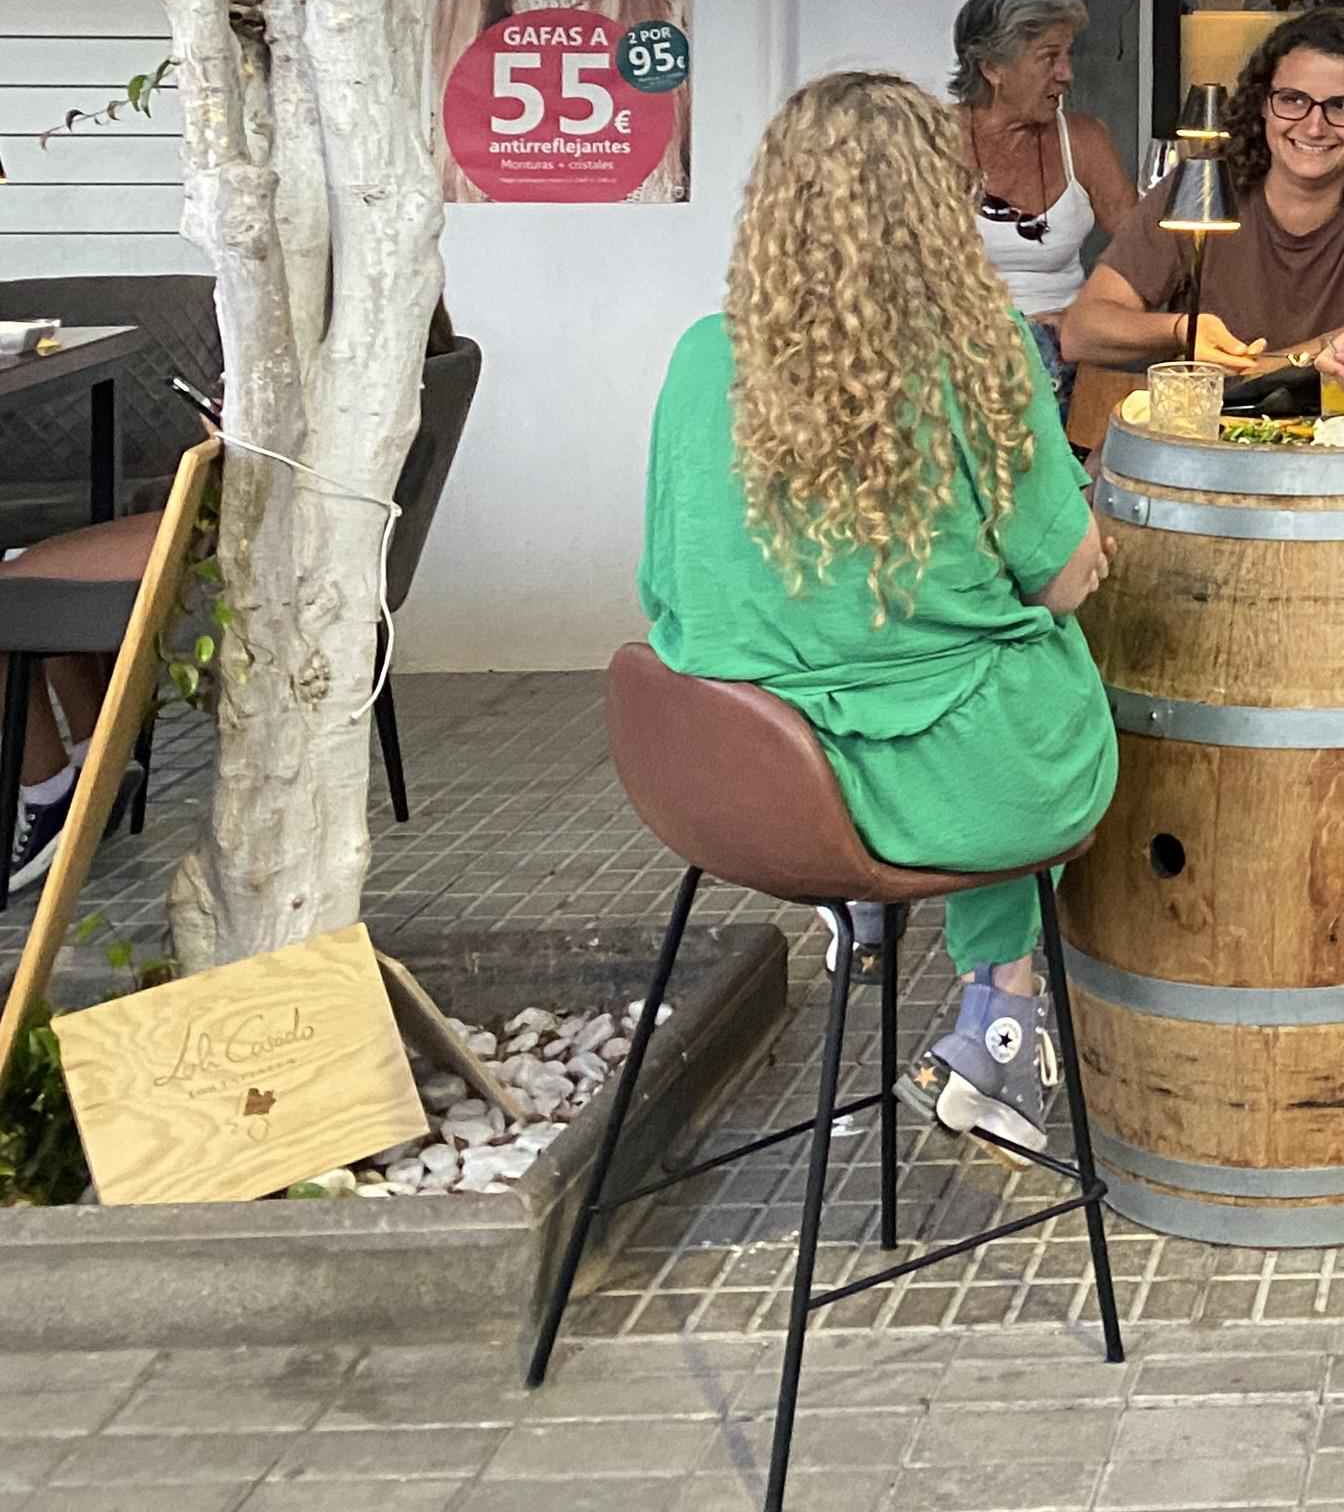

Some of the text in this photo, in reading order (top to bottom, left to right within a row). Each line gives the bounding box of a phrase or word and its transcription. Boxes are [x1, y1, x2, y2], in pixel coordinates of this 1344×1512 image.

[503, 26, 609, 47] GAFAS A
[628, 27, 671, 44] 2 POR
[489, 137, 631, 158] antirreflejantes
[501, 159, 554, 169] Monturas
